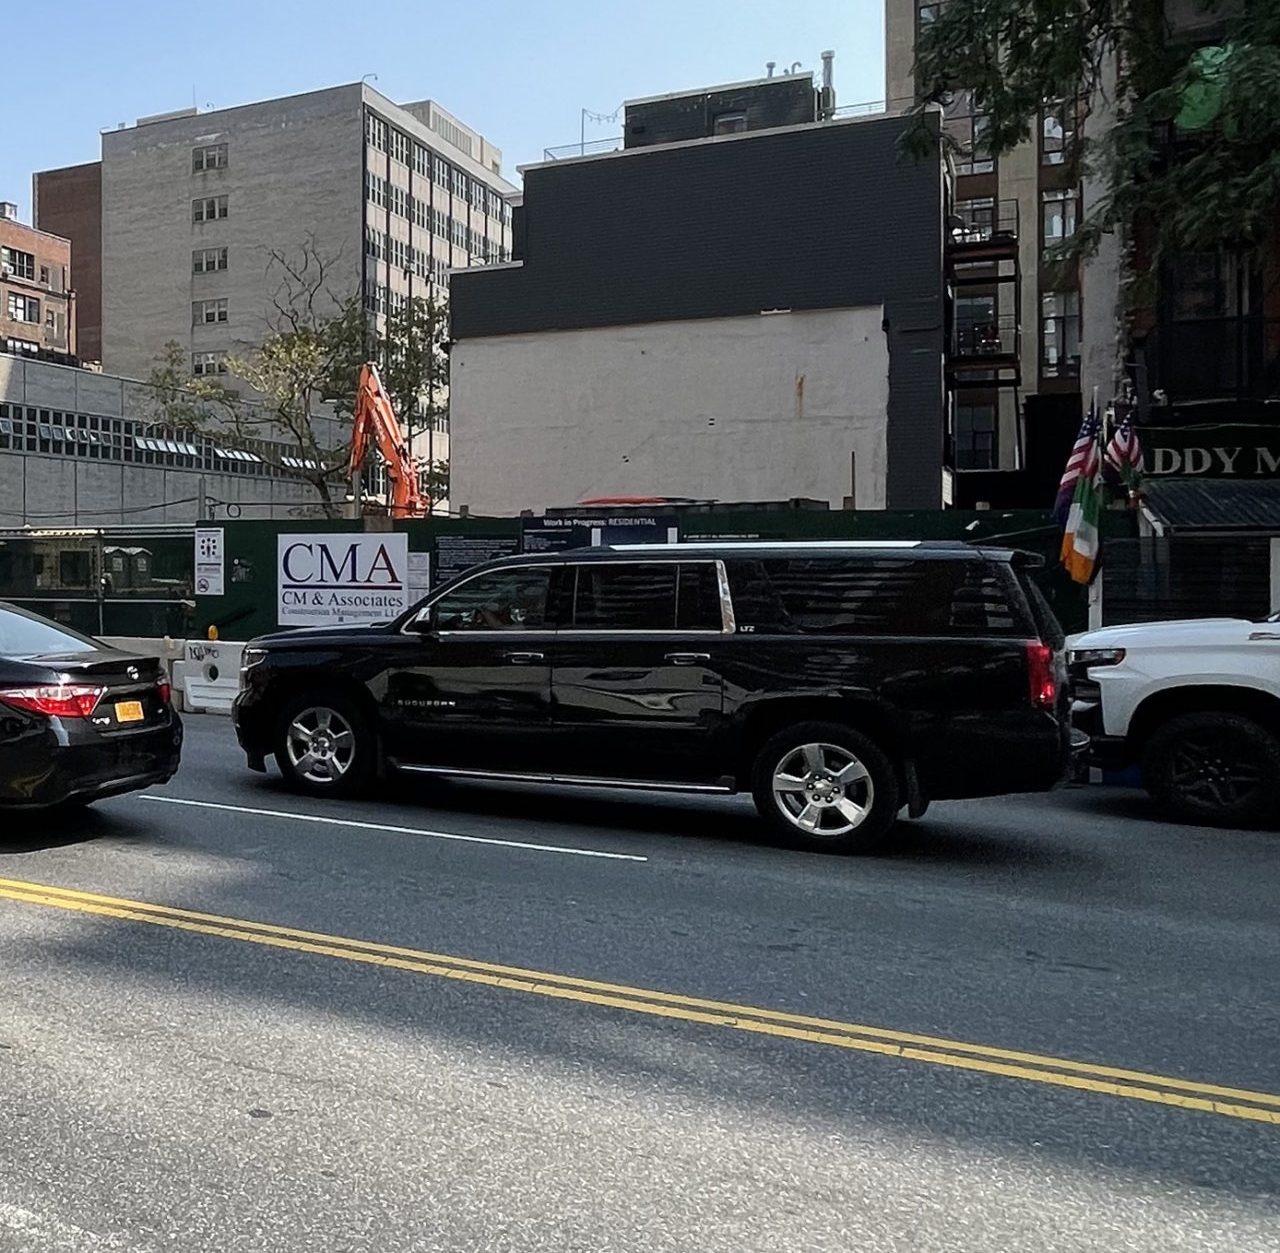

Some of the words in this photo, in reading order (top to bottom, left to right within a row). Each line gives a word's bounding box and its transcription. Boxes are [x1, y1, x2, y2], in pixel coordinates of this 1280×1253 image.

[1143, 447, 1242, 474] DDY
[543, 519, 563, 527] Work
[564, 518, 572, 526] in
[608, 518, 657, 526] RESIDENTIAL
[282, 542, 403, 583] CMA
[282, 591, 307, 605] CM
[312, 591, 324, 605] &
[328, 592, 404, 607] Associates
[282, 607, 330, 616] Construction
[332, 608, 382, 619] Management
